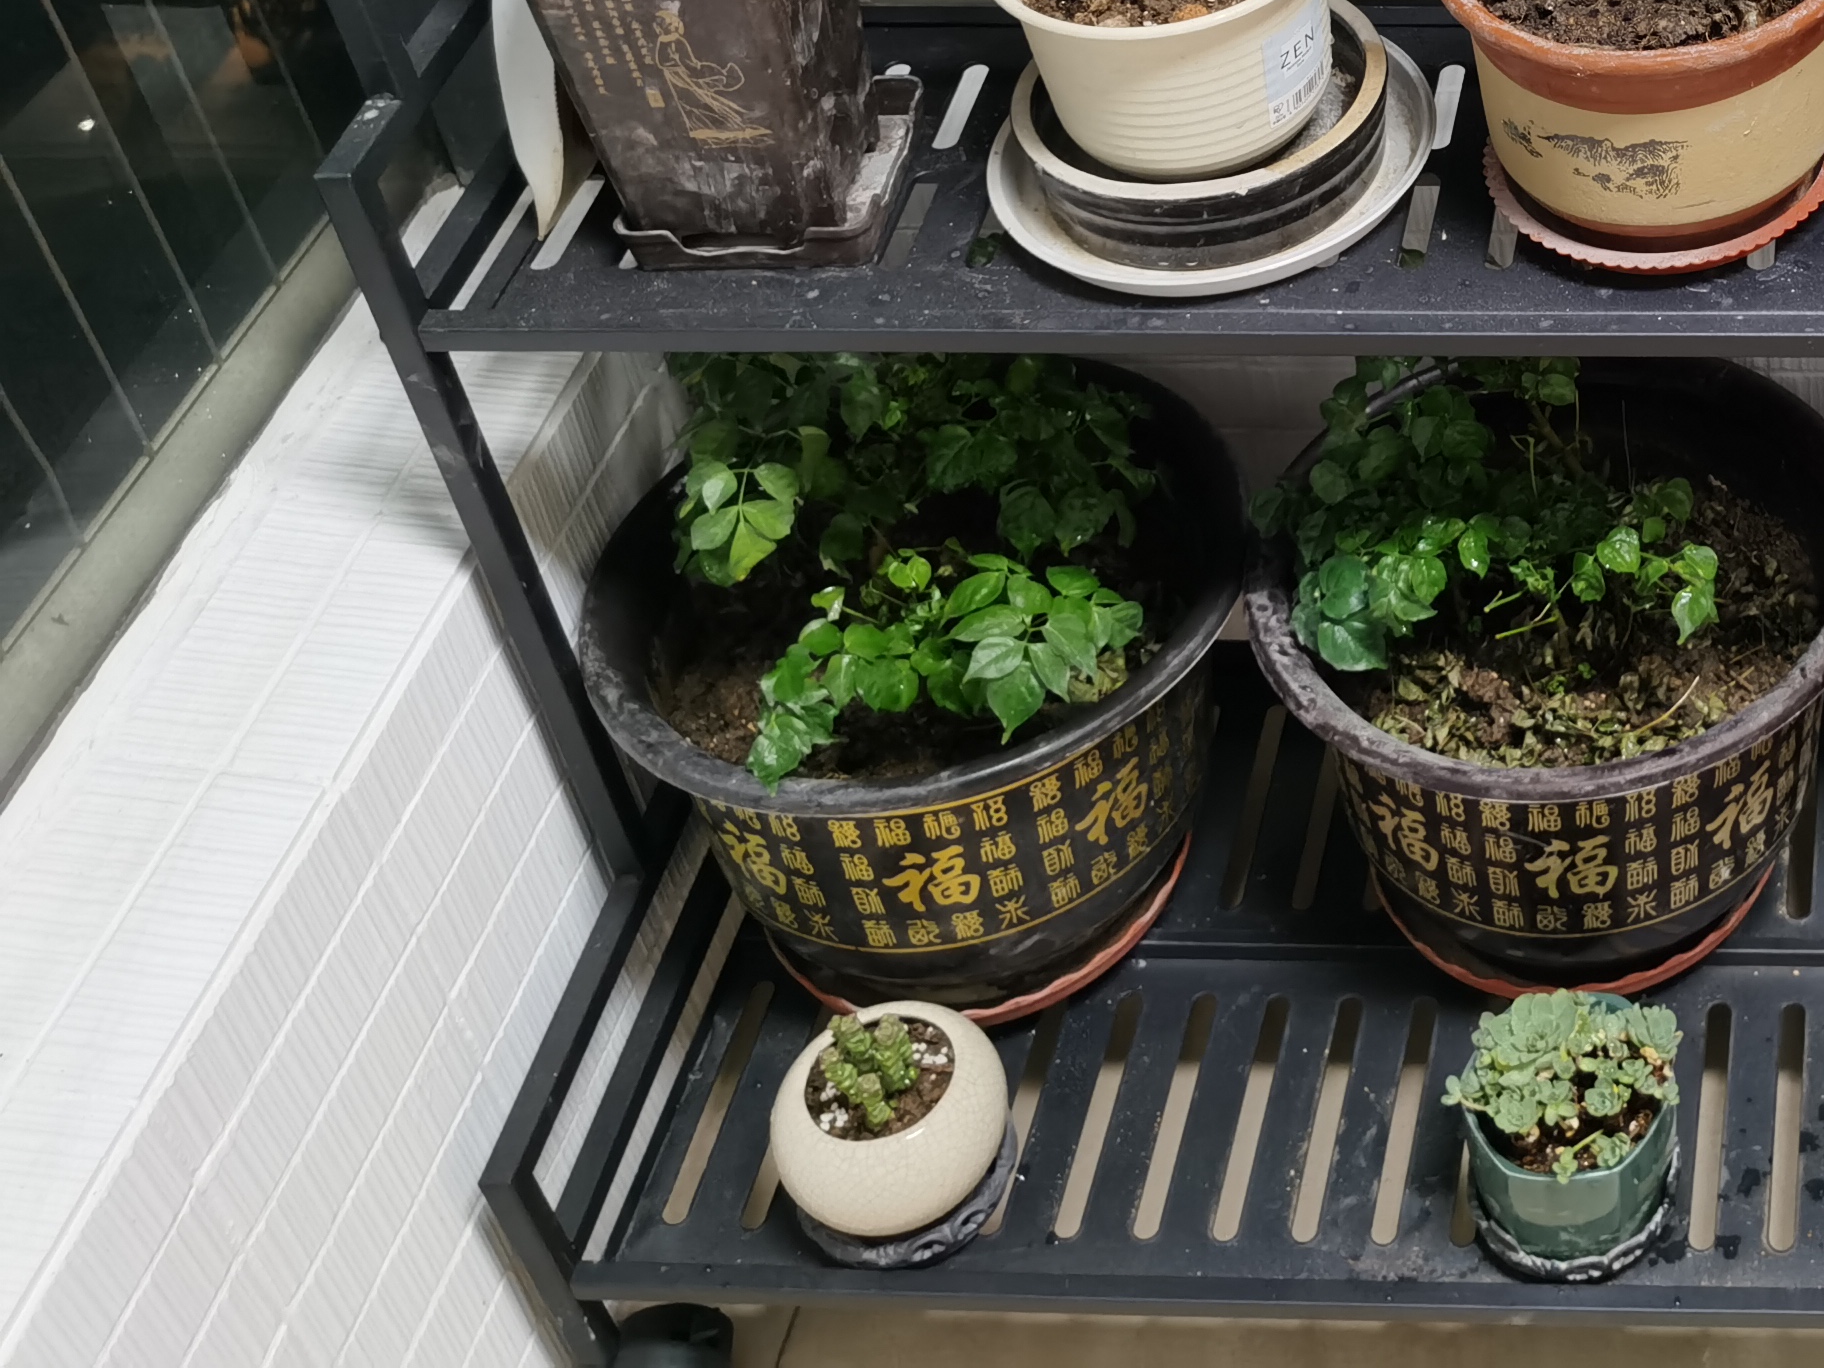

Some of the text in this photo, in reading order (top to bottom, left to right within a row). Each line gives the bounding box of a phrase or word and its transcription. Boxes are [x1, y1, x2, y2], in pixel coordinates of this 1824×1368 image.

[1280, 26, 1314, 70] ZEN
[1075, 757, 1148, 845] 福
[1368, 792, 1439, 872] 福
[1706, 759, 1774, 849] 福
[719, 819, 787, 895] 福
[882, 845, 981, 912] 福
[1524, 835, 1619, 899] 福
